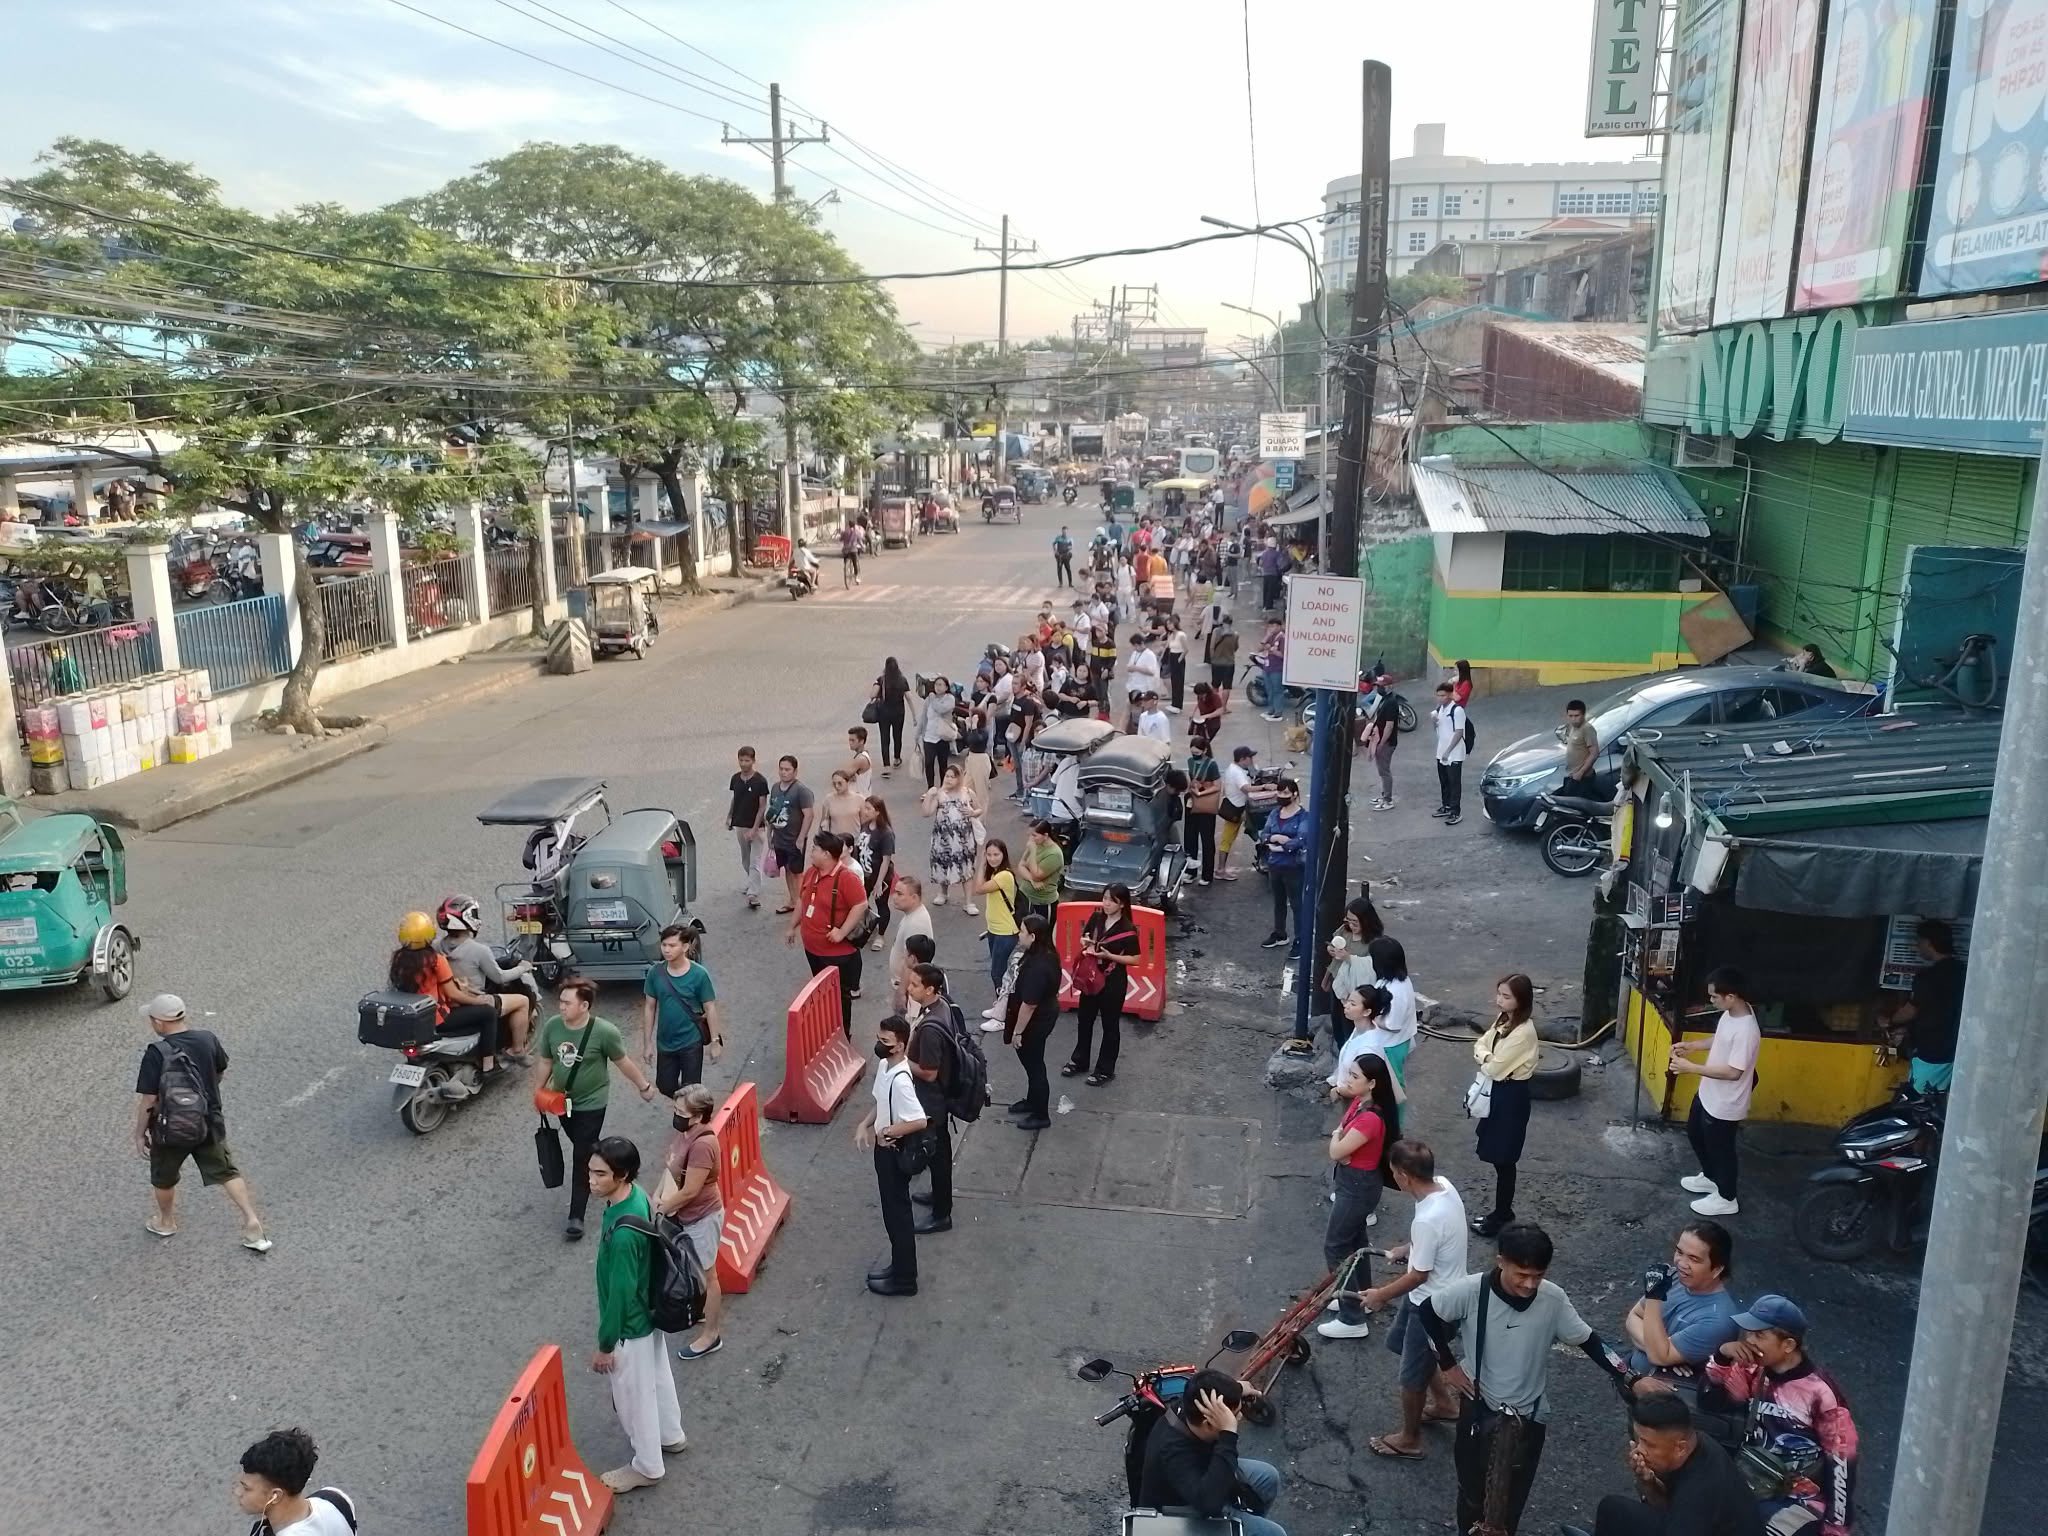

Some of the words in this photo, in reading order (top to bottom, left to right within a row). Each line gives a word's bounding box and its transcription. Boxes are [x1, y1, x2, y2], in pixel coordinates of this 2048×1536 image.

[1624, 121, 1647, 129] CITY
[1952, 226, 2013, 257] MELAMINE
[1690, 307, 1859, 445] NOVO
[1850, 351, 1917, 418] UNICIRCLE
[1914, 347, 1982, 421] GENERAL
[1318, 587, 1334, 596] NO
[1301, 601, 1349, 613] LOADING
[1312, 617, 1336, 627] AND
[1292, 631, 1355, 644] UNLOADING
[1307, 647, 1337, 658] ZONE
[5, 955, 35, 967] 023
